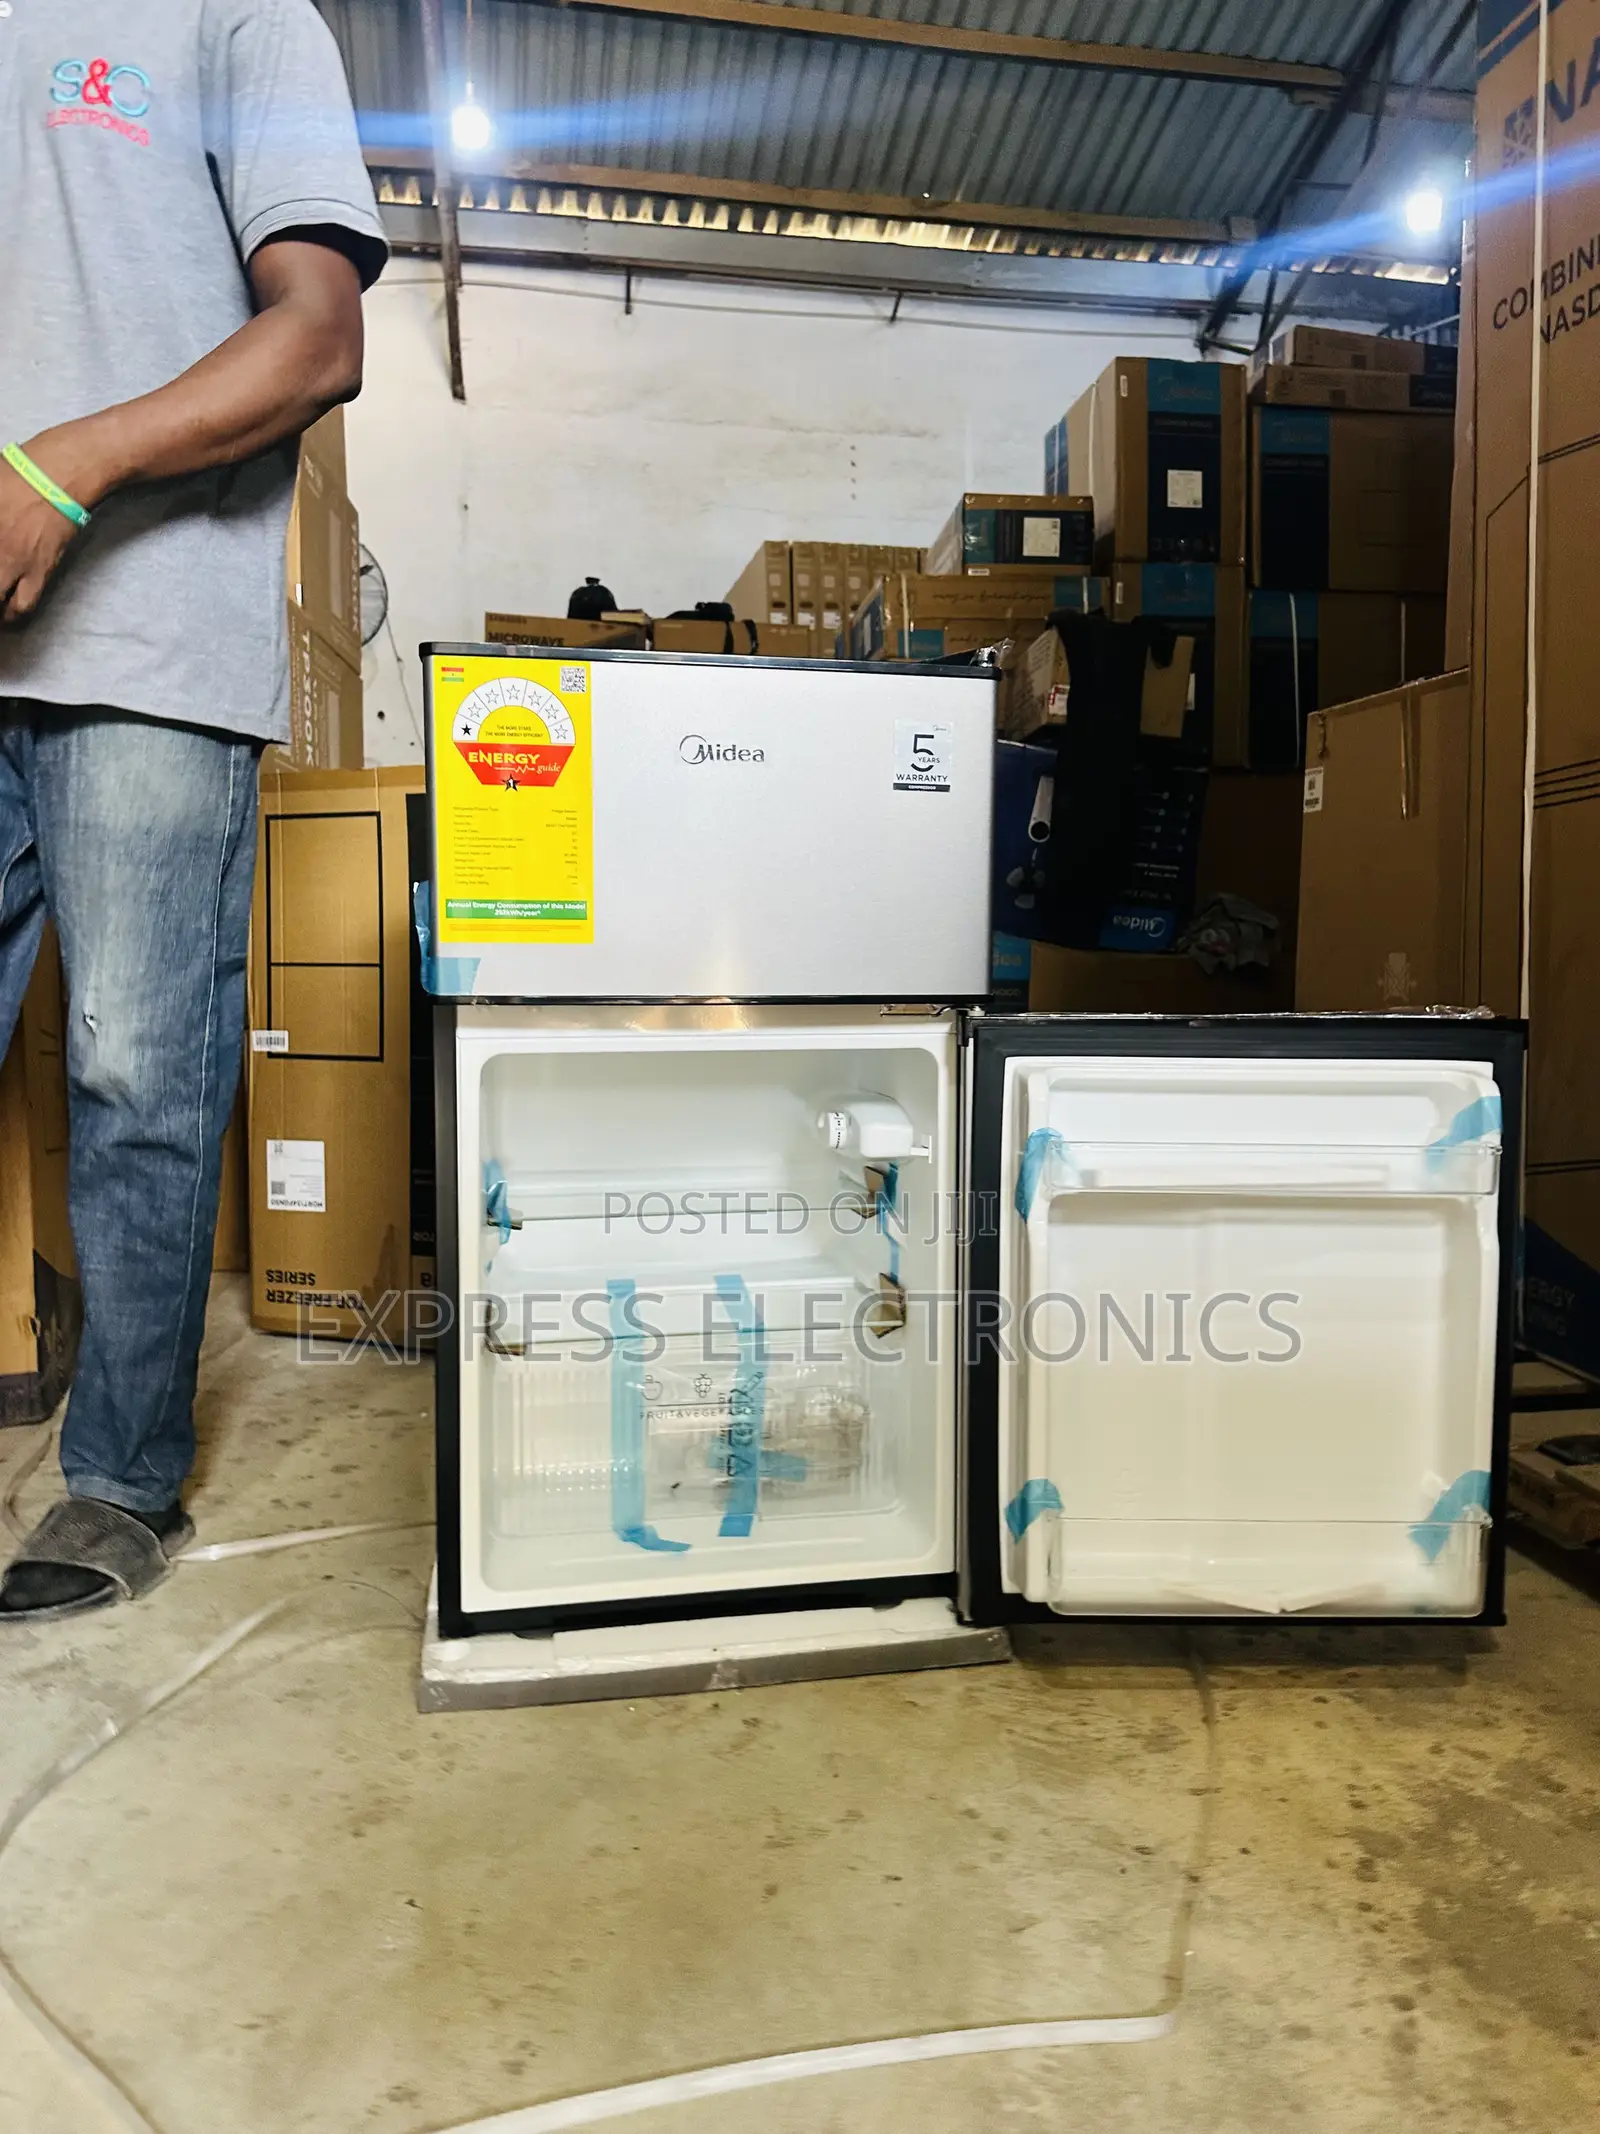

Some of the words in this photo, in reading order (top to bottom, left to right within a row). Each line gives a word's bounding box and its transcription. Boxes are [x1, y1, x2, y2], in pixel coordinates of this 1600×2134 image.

[49, 57, 151, 118] S&C
[1493, 233, 1600, 330] COMBIN
[488, 631, 565, 647] MICROWAVE
[468, 749, 541, 767] ENERGY
[679, 734, 765, 765] Midea
[911, 733, 935, 773] 5
[537, 762, 561, 775] guide
[917, 756, 941, 764] YEARS
[895, 773, 949, 783] WARRANTY
[472, 901, 496, 910] Energy
[496, 902, 542, 910] Consumption
[564, 902, 586, 910] Model
[1112, 915, 1167, 938] Midea
[266, 1269, 316, 1287] SERIES
[266, 1287, 335, 1309] FREEZER
